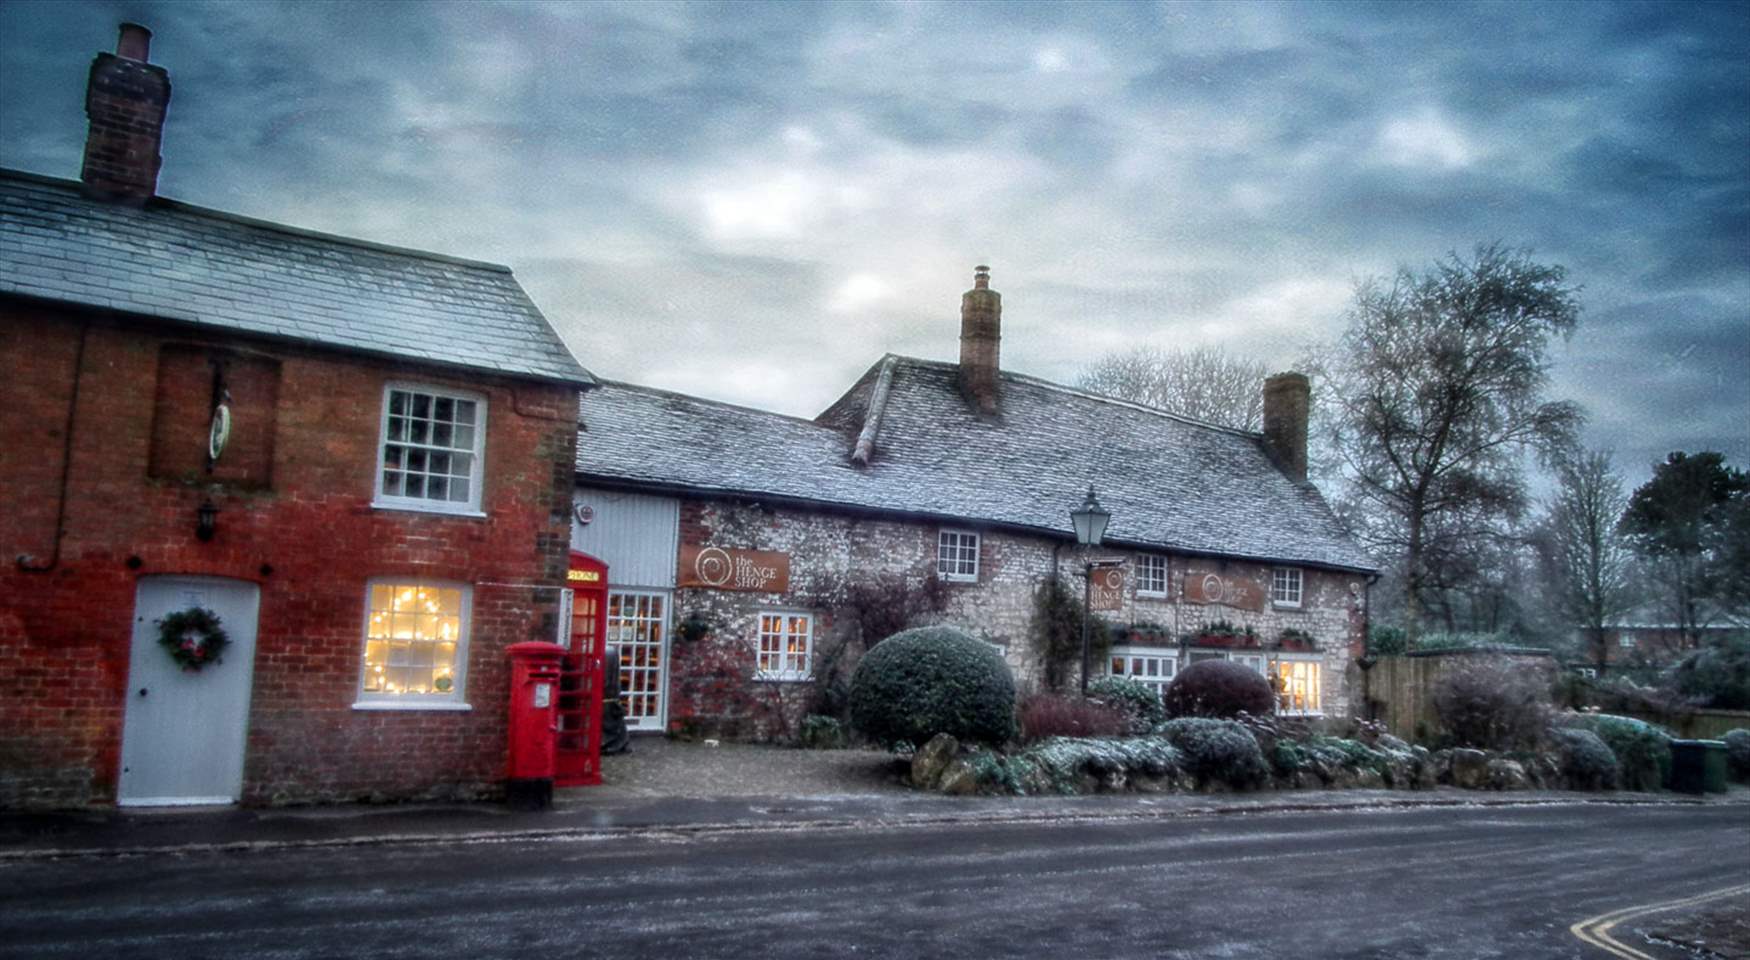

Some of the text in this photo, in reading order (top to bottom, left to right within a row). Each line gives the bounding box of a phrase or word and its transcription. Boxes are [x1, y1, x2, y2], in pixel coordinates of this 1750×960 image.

[735, 555, 753, 567] the
[735, 565, 777, 579] HENGE
[735, 576, 767, 588] SHOP
